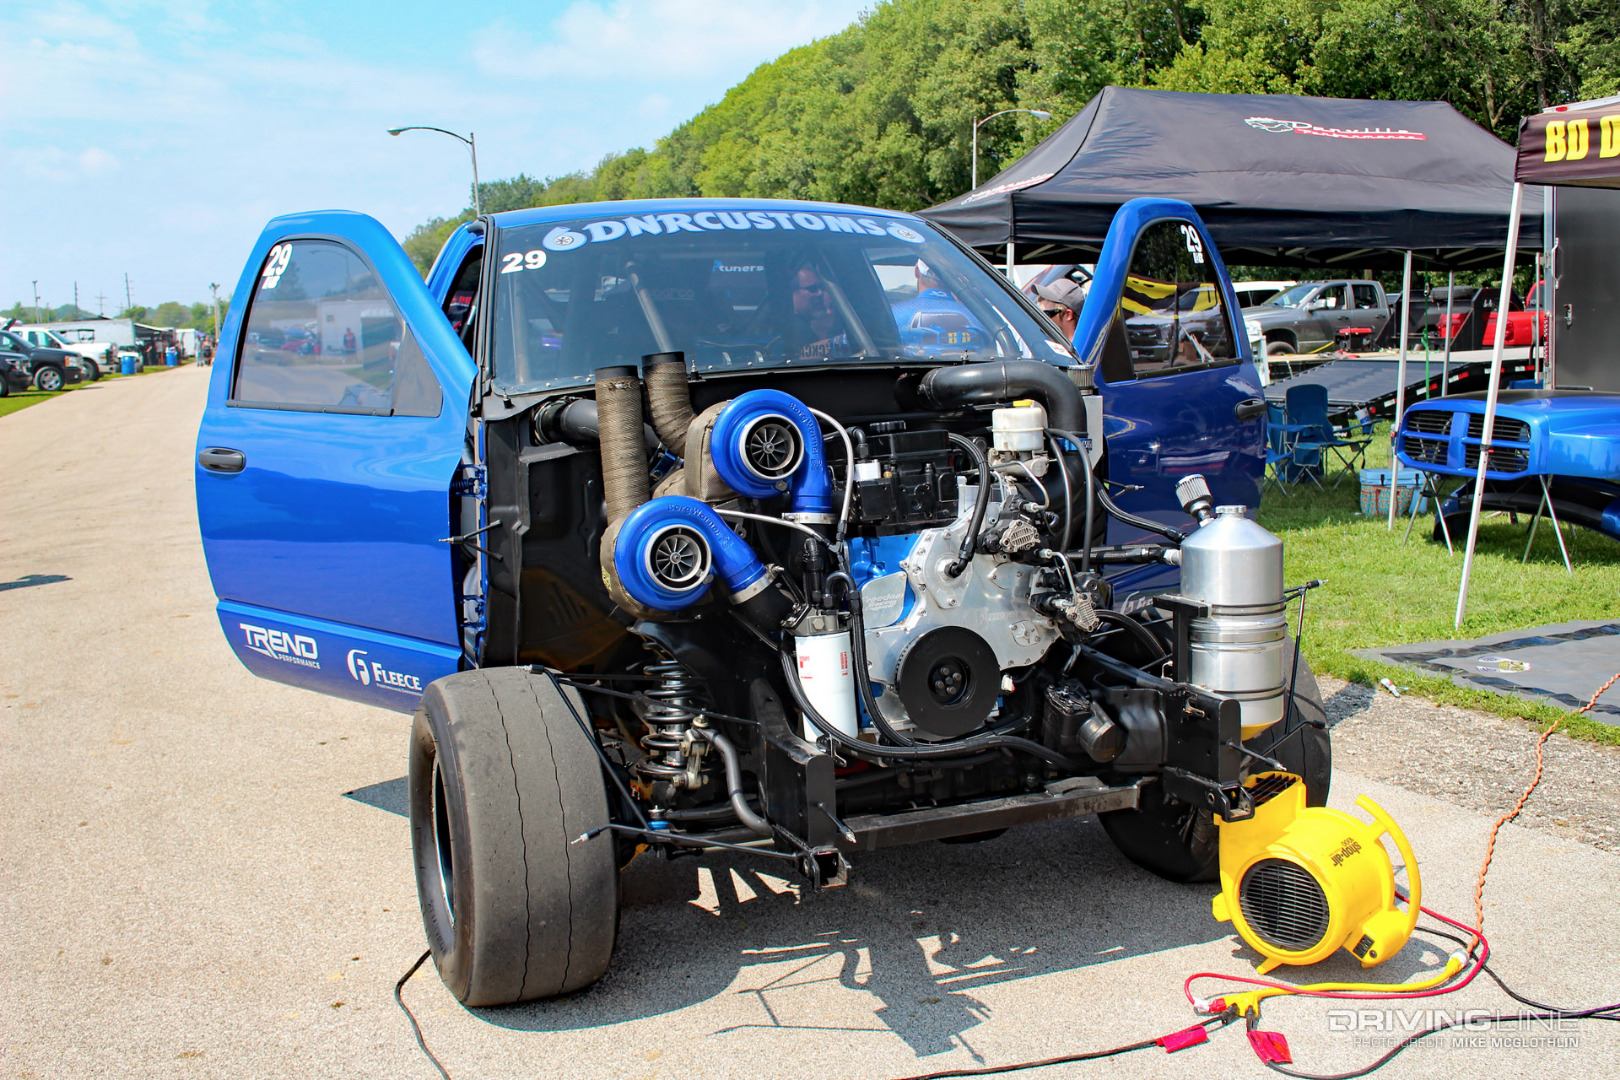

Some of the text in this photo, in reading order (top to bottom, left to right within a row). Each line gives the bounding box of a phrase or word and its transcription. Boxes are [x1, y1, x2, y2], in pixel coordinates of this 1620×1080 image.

[1544, 118, 1589, 162] BD
[582, 210, 888, 243] DNRCUSTOMS
[1180, 224, 1202, 252] 29
[262, 243, 293, 276] 29
[501, 249, 547, 274] 29
[239, 622, 318, 660] TREND
[278, 653, 321, 670] PERFORMANCE
